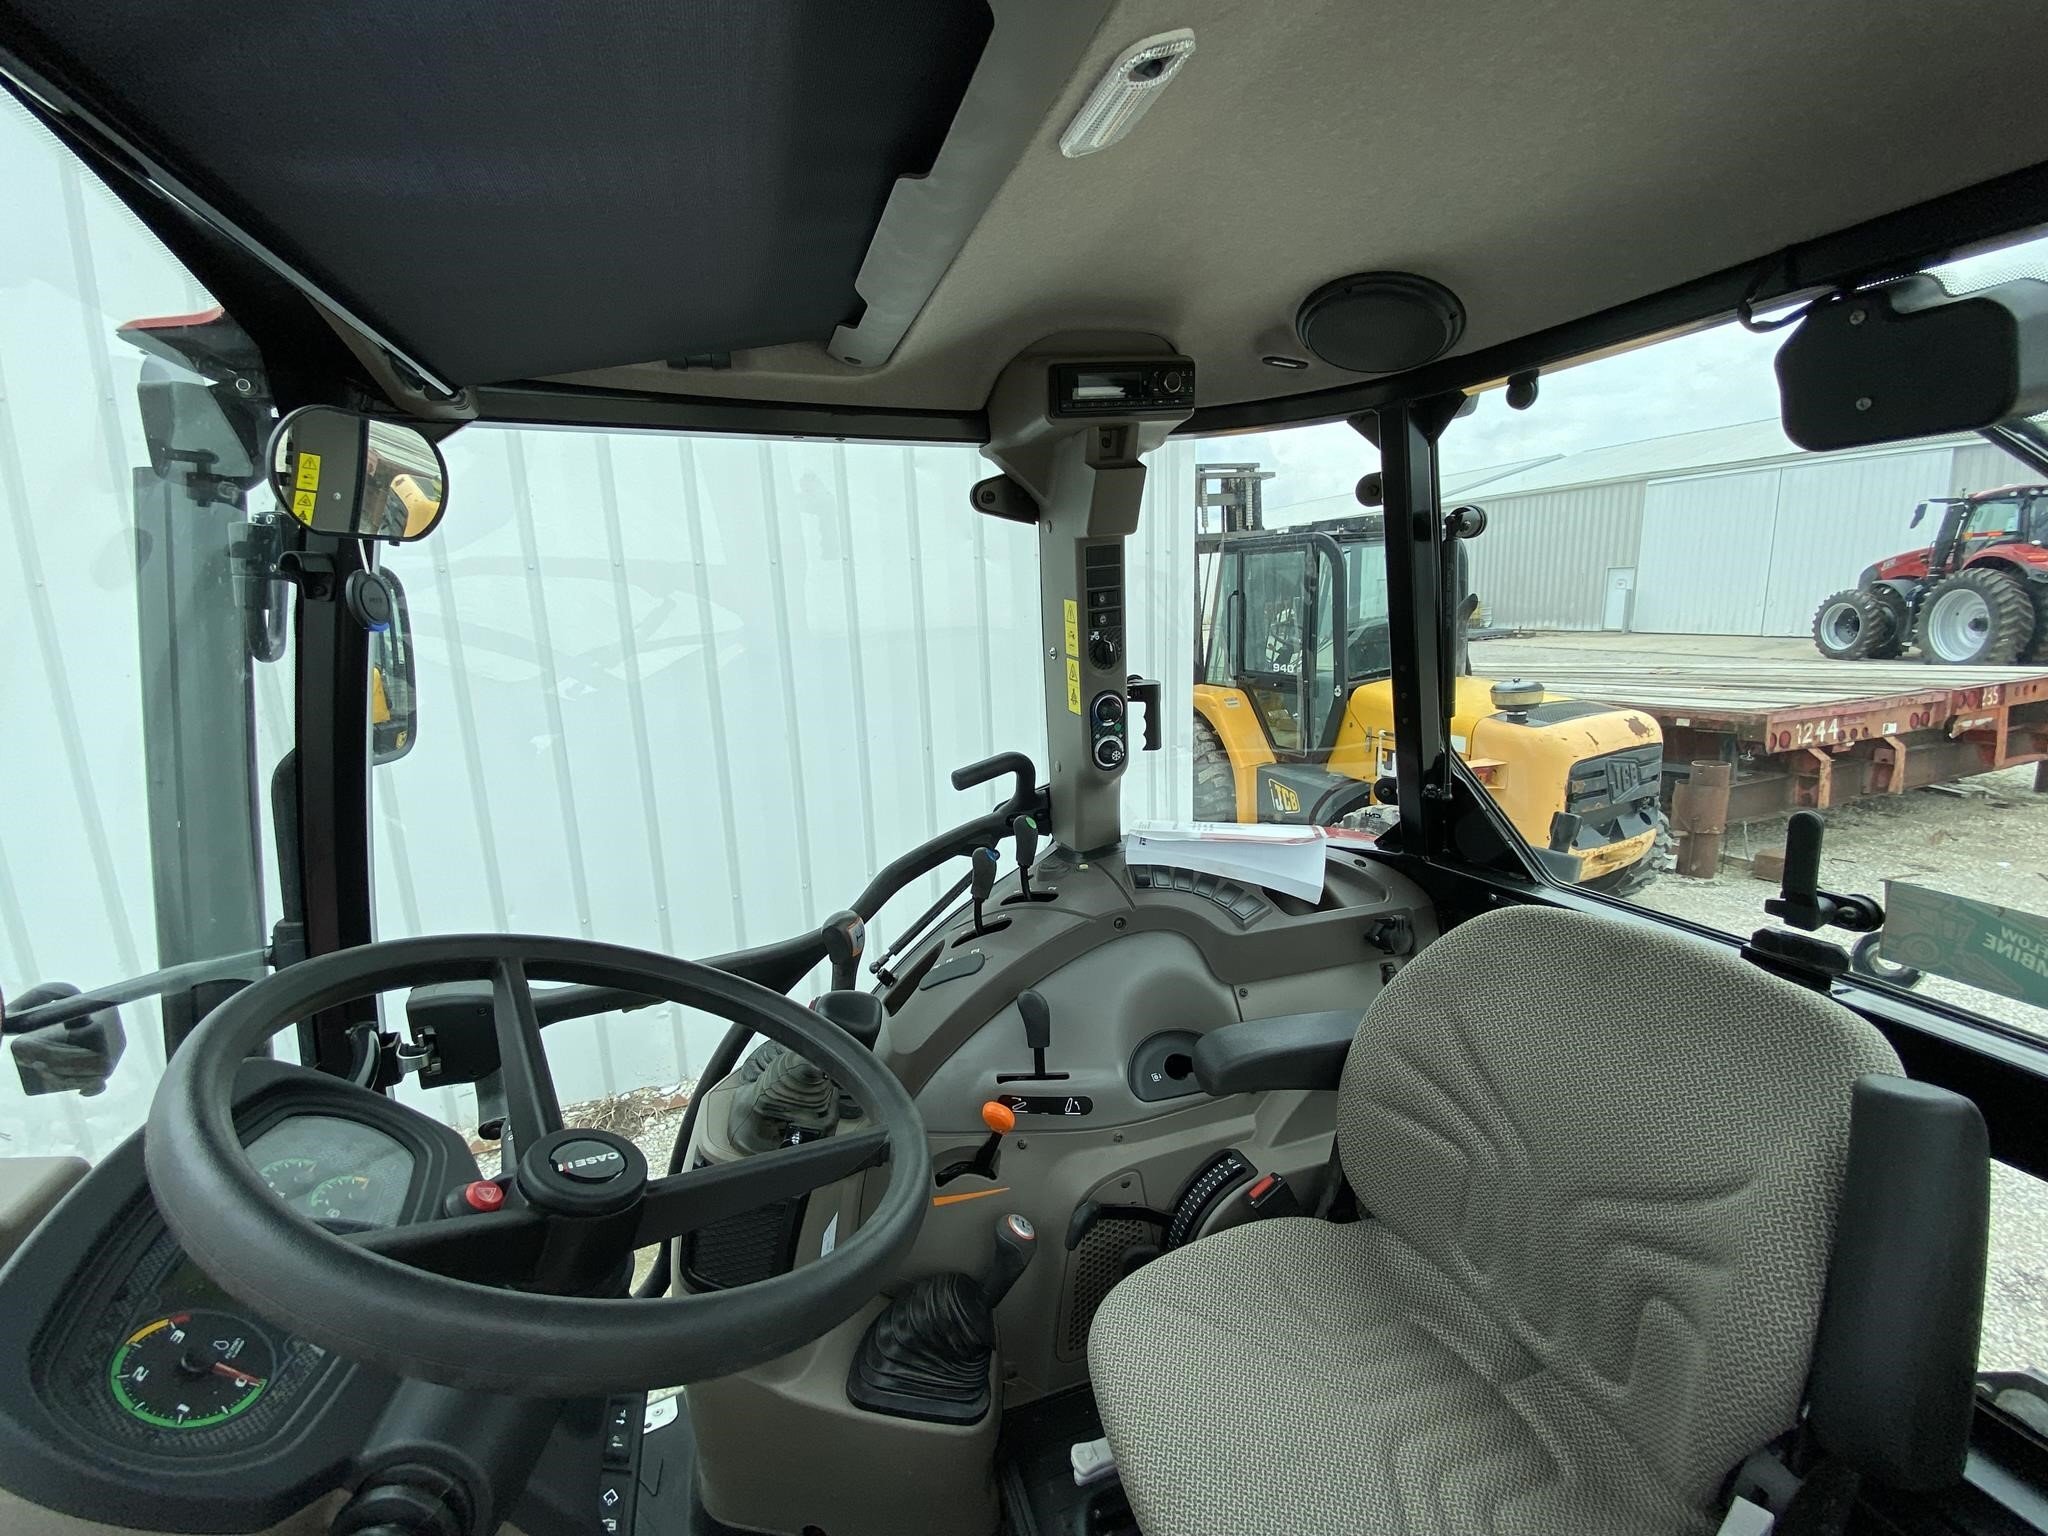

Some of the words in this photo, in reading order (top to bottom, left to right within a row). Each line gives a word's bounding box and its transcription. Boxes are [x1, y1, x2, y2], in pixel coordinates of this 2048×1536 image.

[1273, 664, 1295, 673] 940
[1796, 718, 1838, 744] 1244
[1274, 783, 1298, 811] JCB
[574, 1151, 619, 1168] CASE
